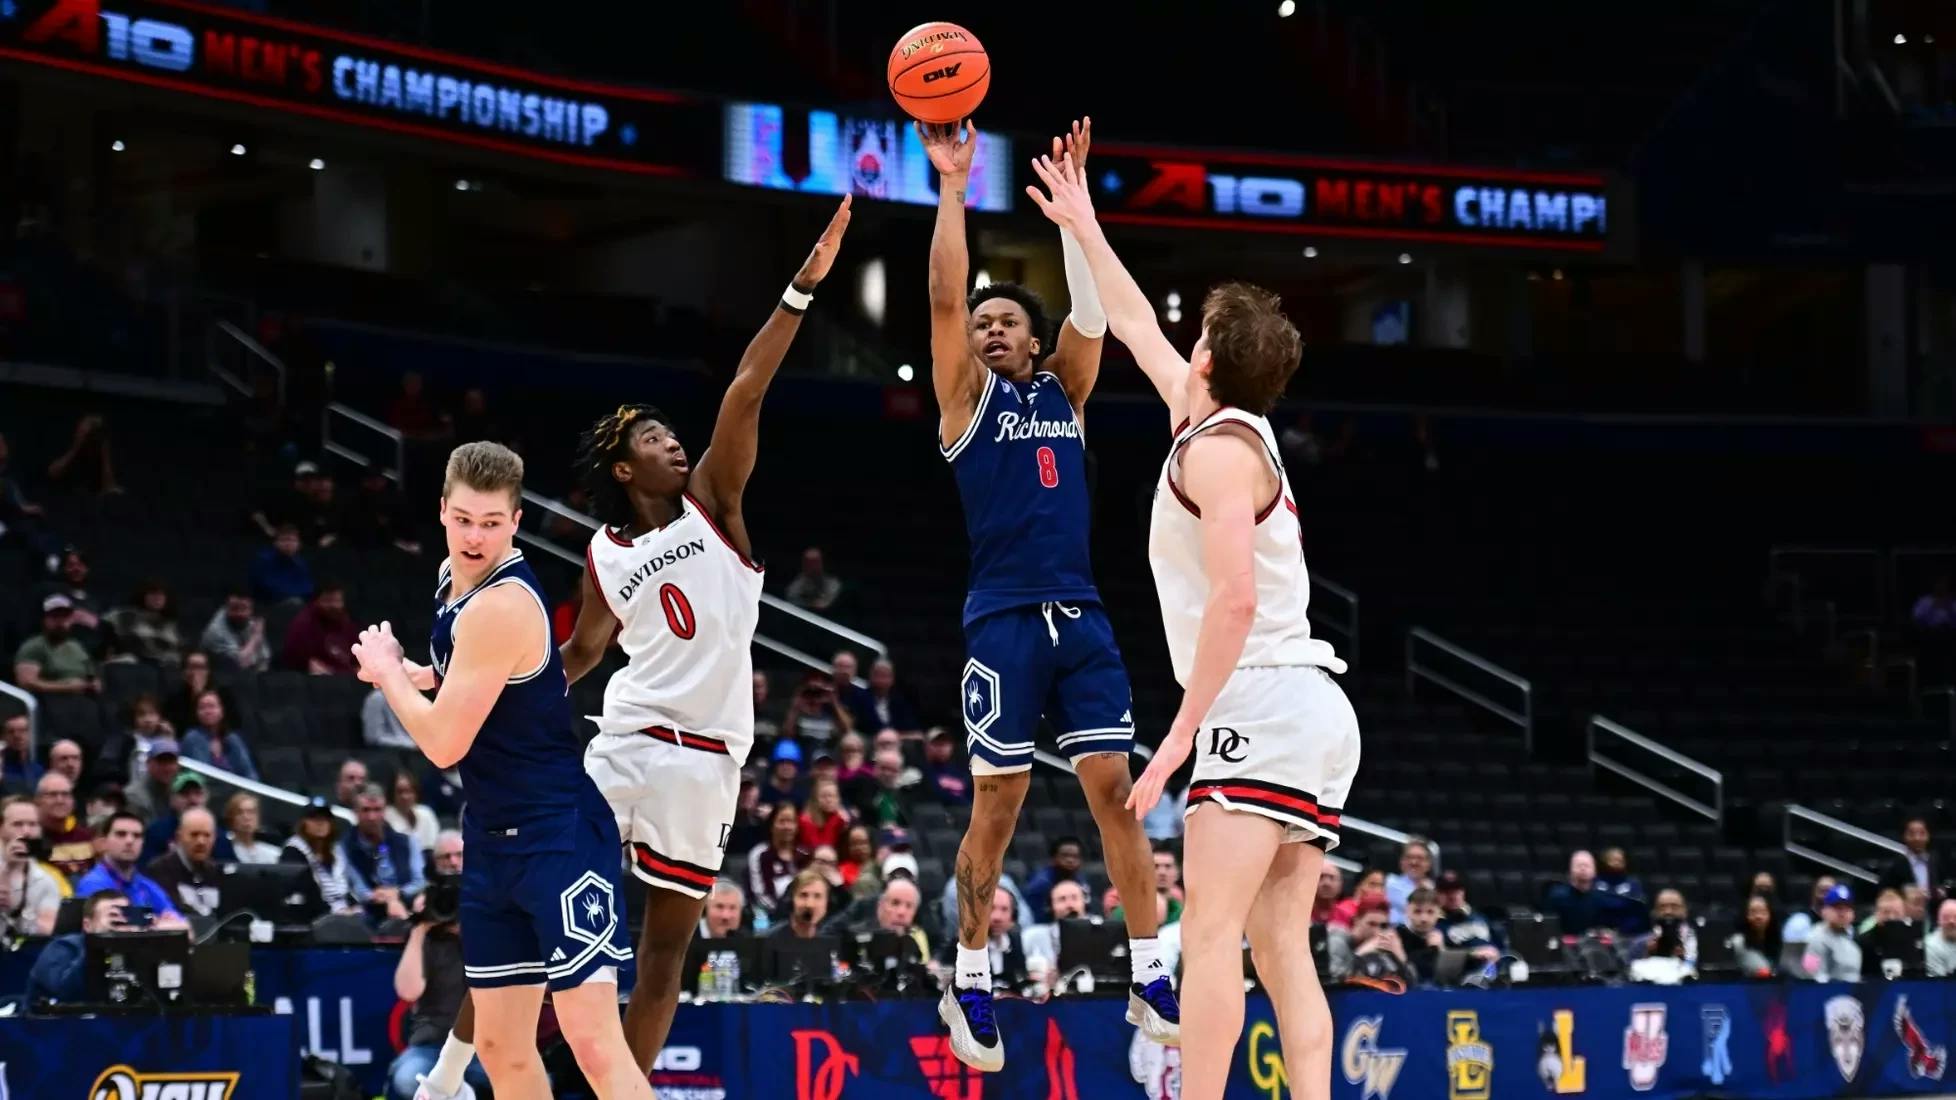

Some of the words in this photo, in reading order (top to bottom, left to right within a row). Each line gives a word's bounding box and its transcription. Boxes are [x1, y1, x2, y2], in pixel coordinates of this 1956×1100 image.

[204, 30, 322, 94] MEN'S
[332, 55, 609, 146] CHAMPIONSHIP
[1315, 177, 1441, 224] MEN'S
[994, 409, 1078, 443] Richmond
[1036, 446, 1059, 489] 8
[618, 539, 706, 602] DAVIDSON
[659, 582, 697, 641] 0
[1208, 726, 1250, 764] DC
[273, 996, 373, 1065] LL
